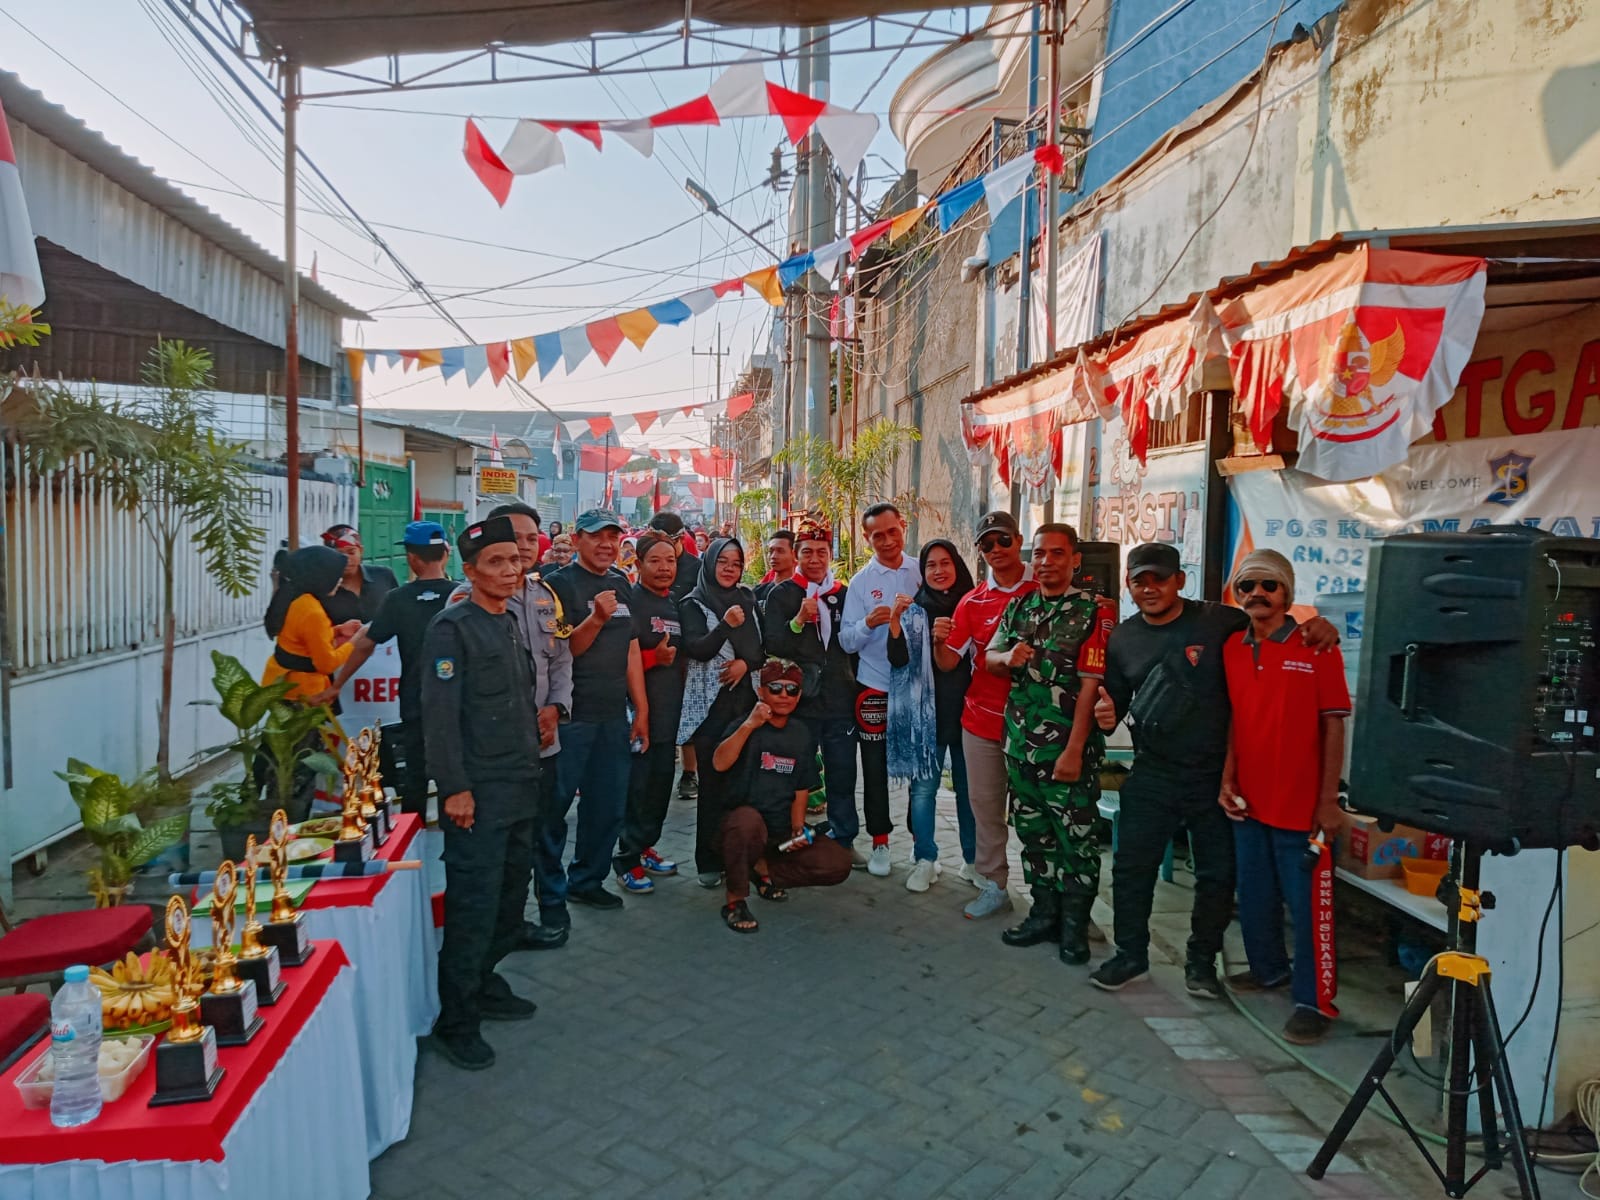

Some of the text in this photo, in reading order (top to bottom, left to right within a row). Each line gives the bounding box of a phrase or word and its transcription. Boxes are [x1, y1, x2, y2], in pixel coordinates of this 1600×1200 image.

[1432, 340, 1600, 441] TGA
[1406, 477, 1481, 491] WELCOME
[1092, 491, 1200, 545] BERSIH
[1265, 519, 1328, 537] POS
[1319, 869, 1333, 906] SMKN
[1319, 911, 1332, 921] 10
